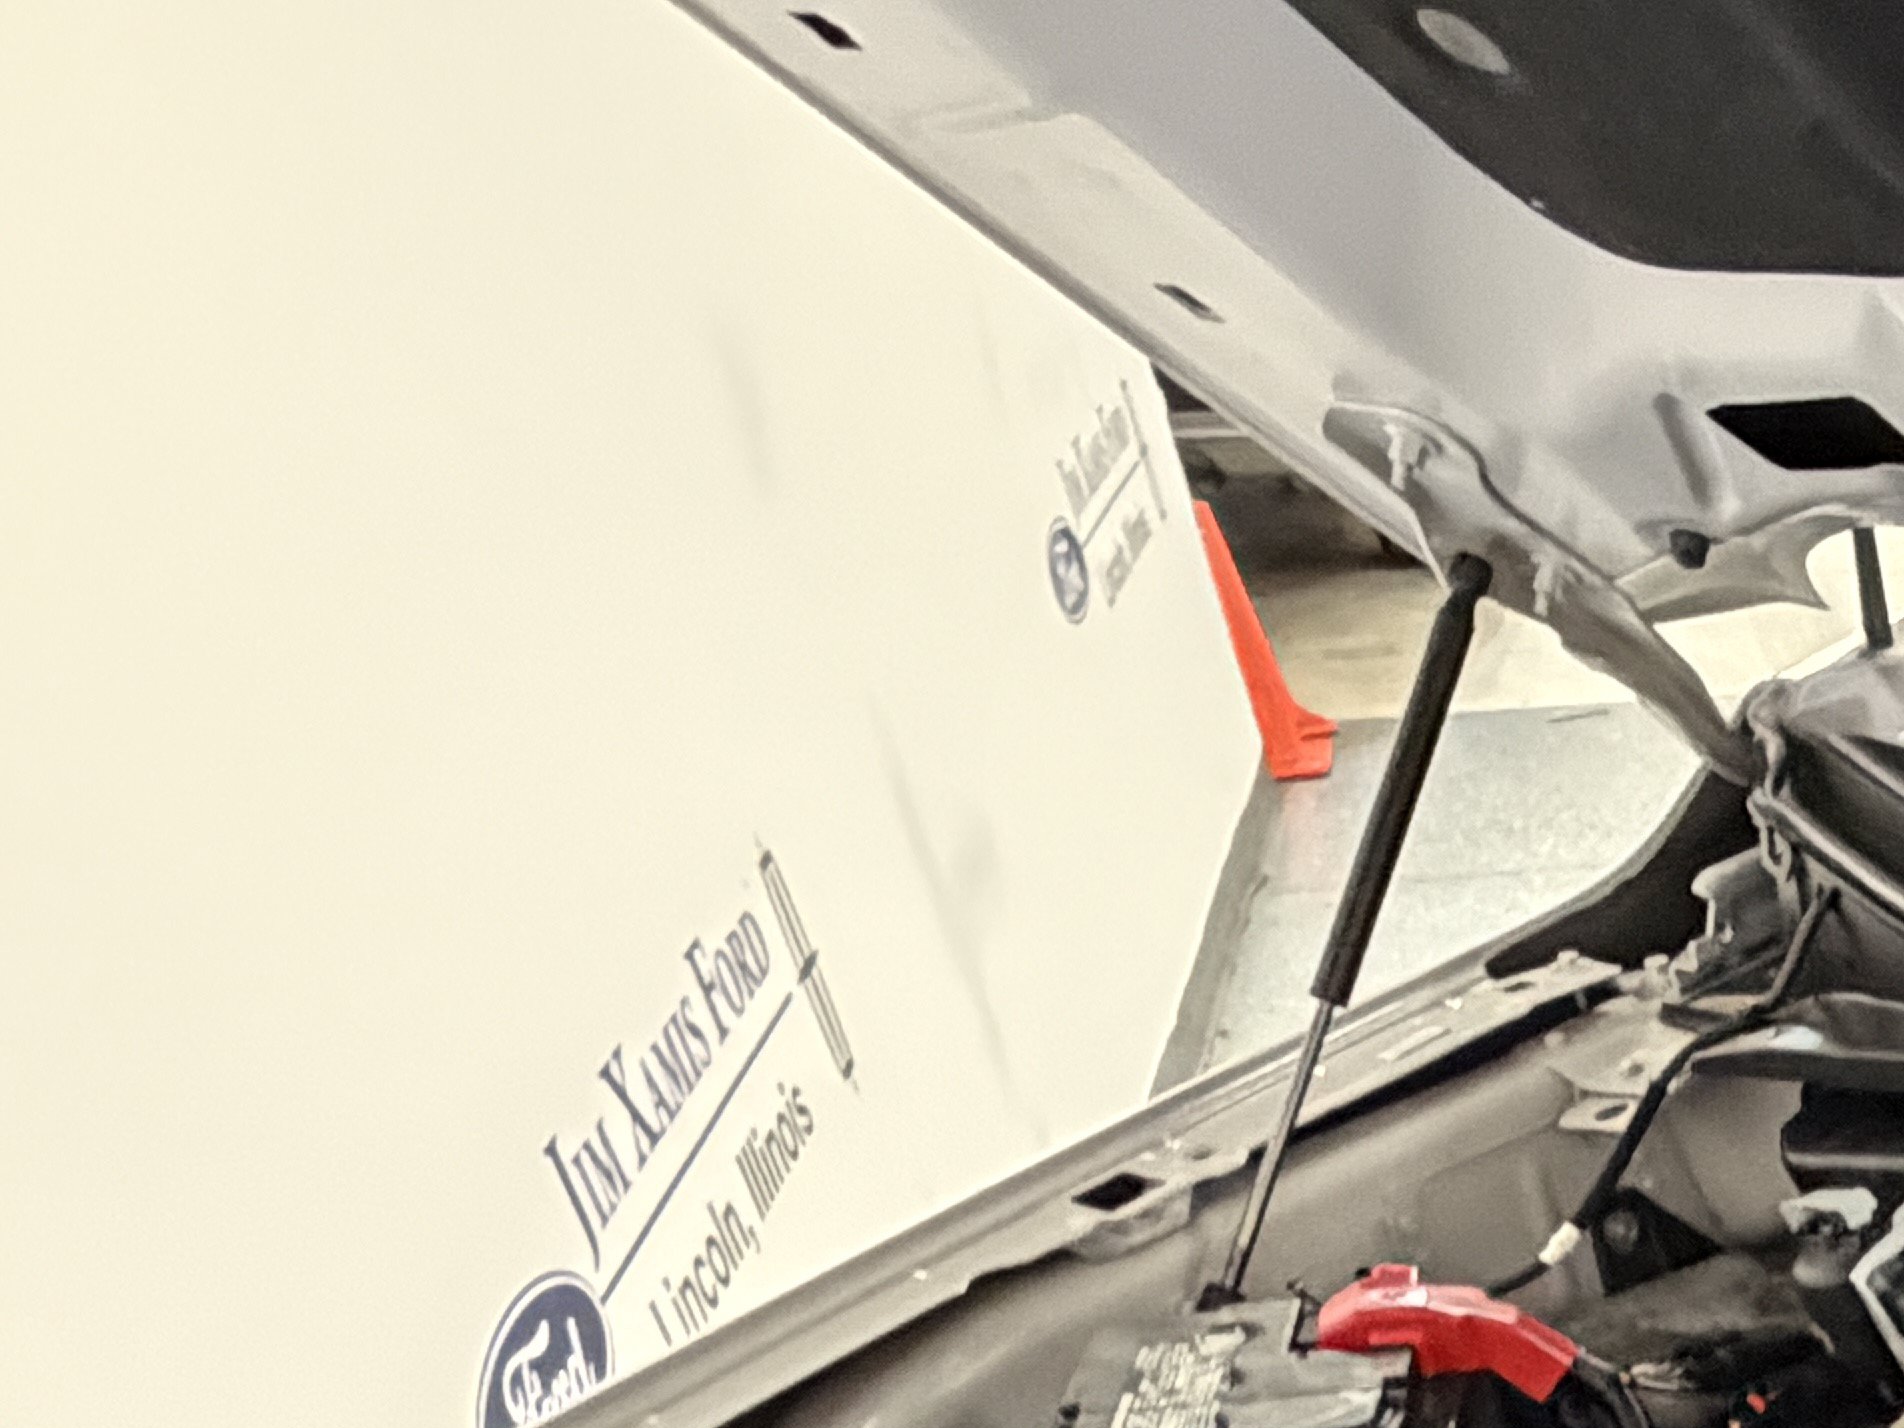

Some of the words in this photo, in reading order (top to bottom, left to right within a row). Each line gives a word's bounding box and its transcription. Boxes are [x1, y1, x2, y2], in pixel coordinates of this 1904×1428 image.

[543, 1132, 633, 1273] JIM
[597, 1042, 713, 1172] XAMIS
[683, 910, 769, 1047] FORD
[735, 1082, 815, 1222] Illinois
